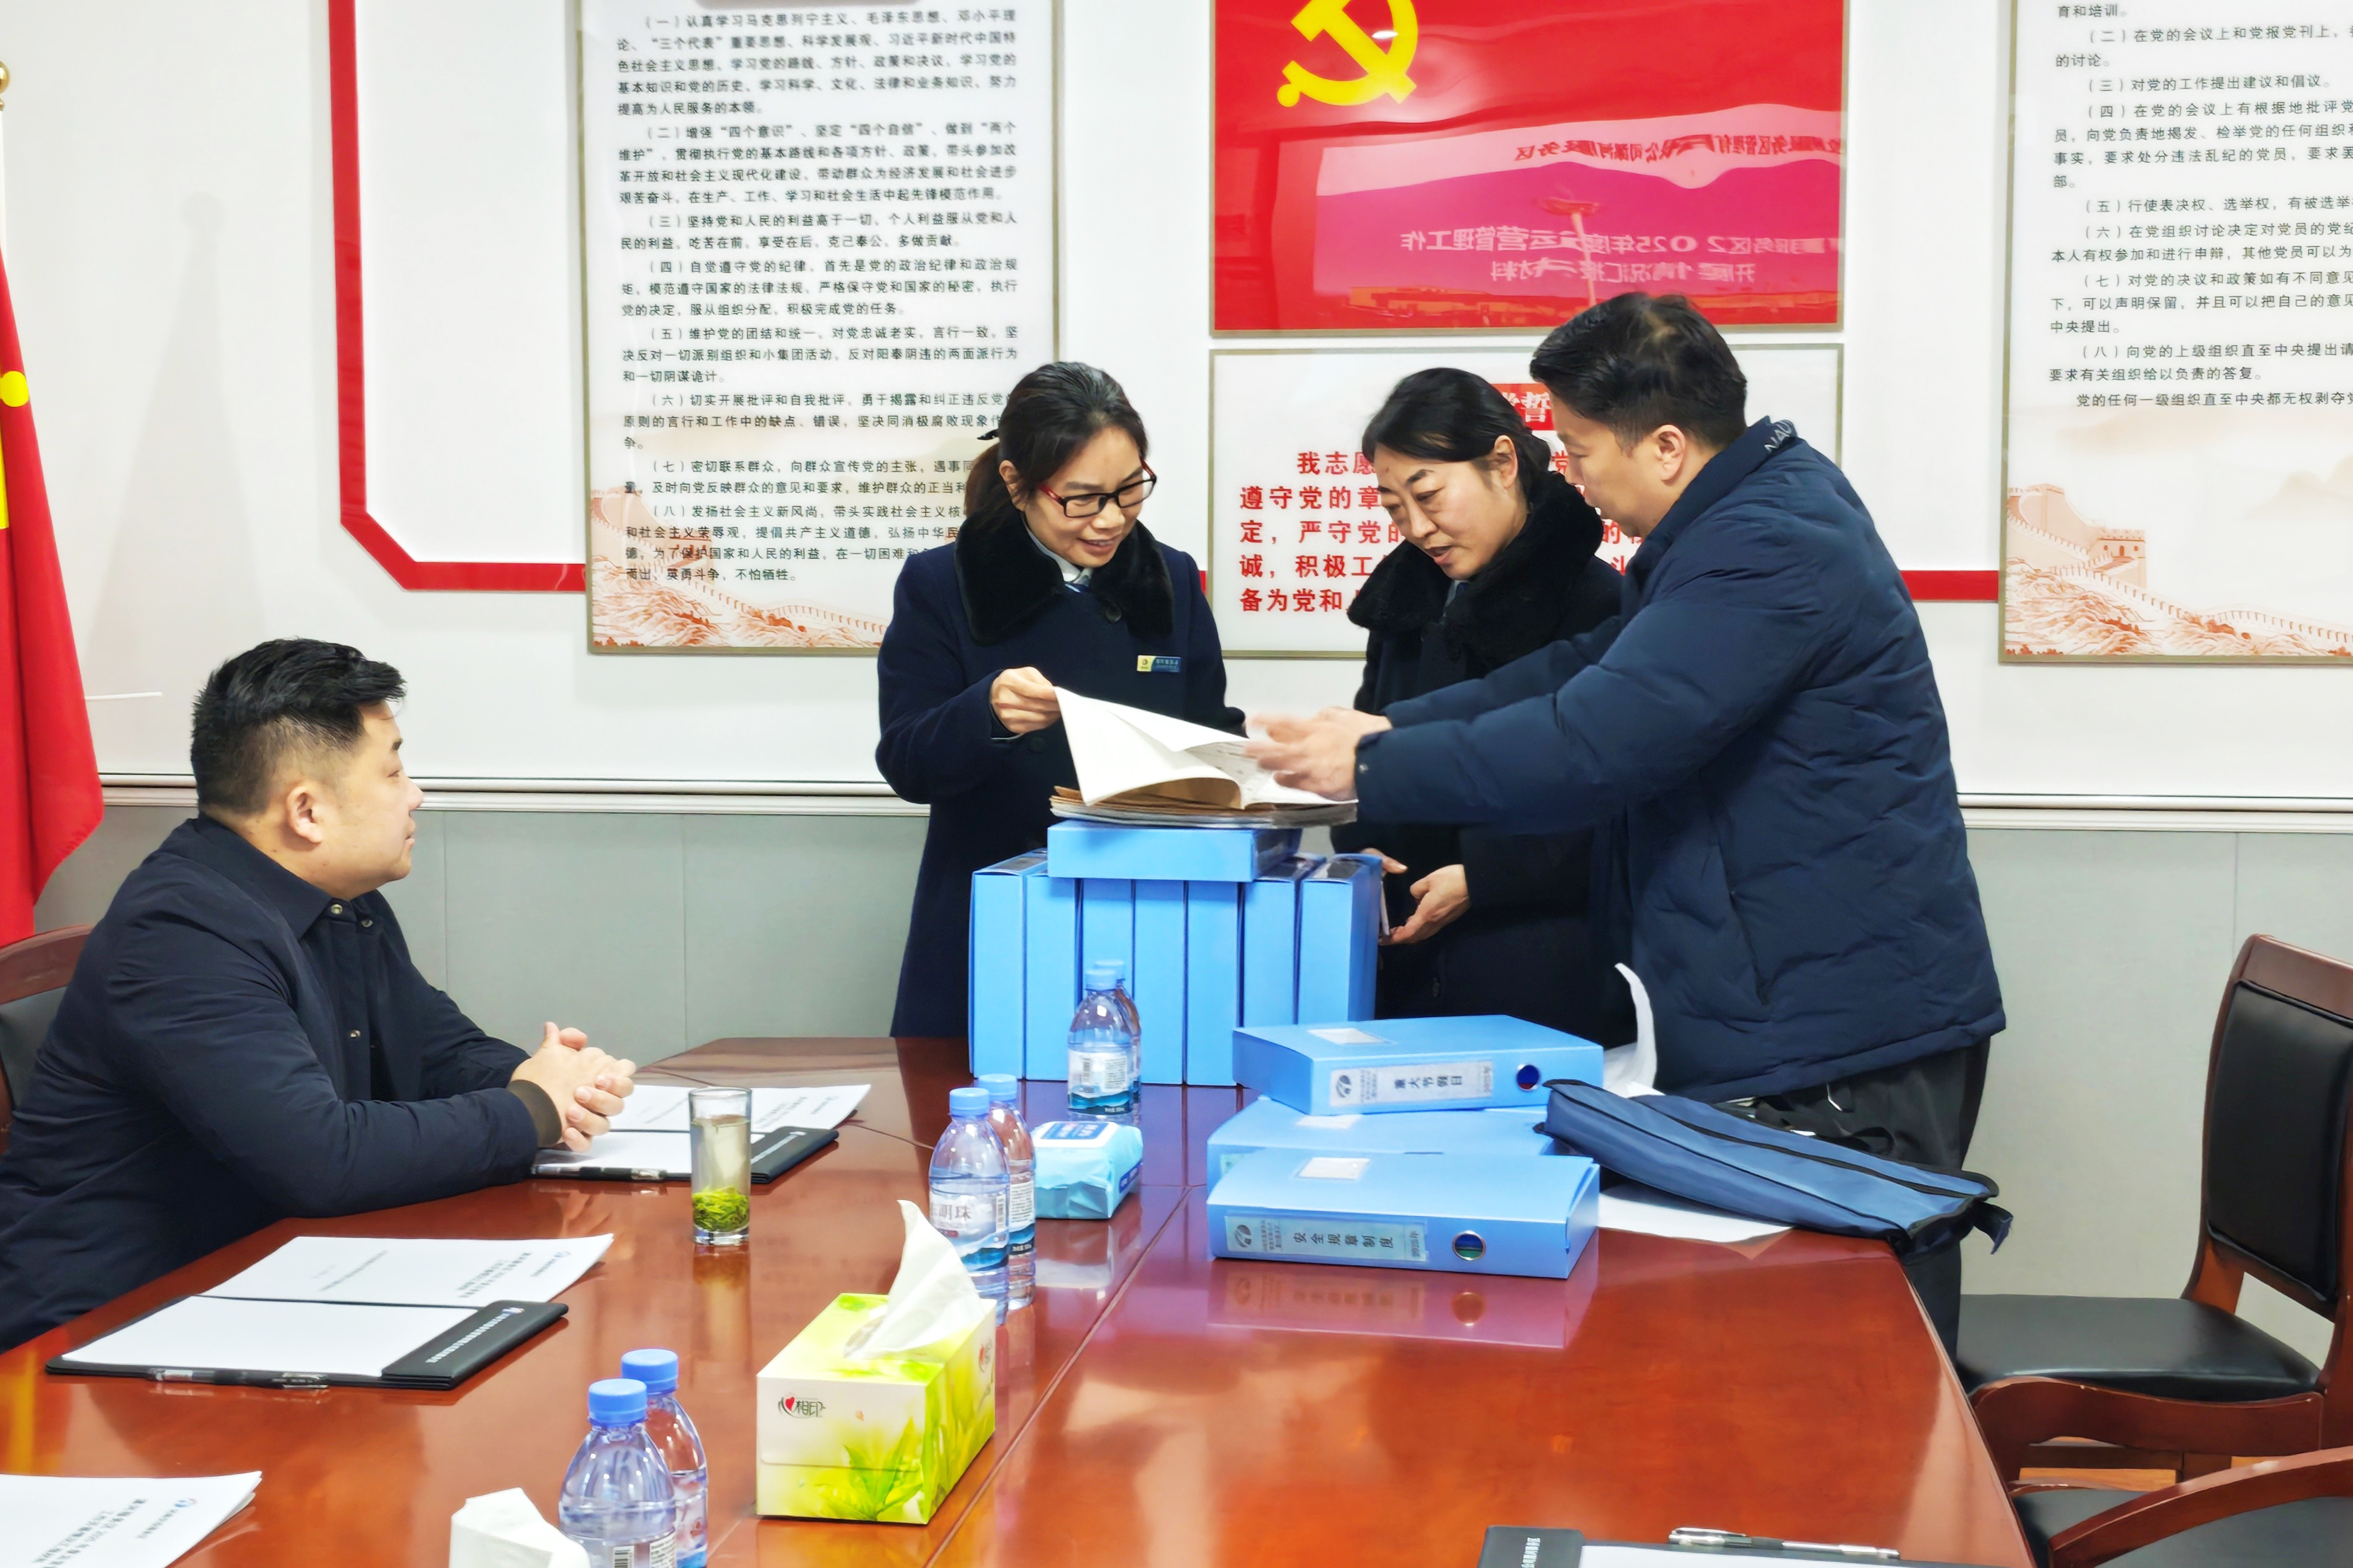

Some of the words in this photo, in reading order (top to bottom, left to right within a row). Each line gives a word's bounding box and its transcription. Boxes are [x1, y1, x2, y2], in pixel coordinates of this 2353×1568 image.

[2086, 195, 2353, 213] （五）行使表决权、选举权，有被选举
[2050, 320, 2121, 334] 中央提出。
[652, 392, 1009, 407] （六）切实开展批评和自我批评，勇于揭露和纠正违反党
[1239, 554, 1390, 578] 诚，积极工
[1239, 588, 1358, 612] 备为党和
